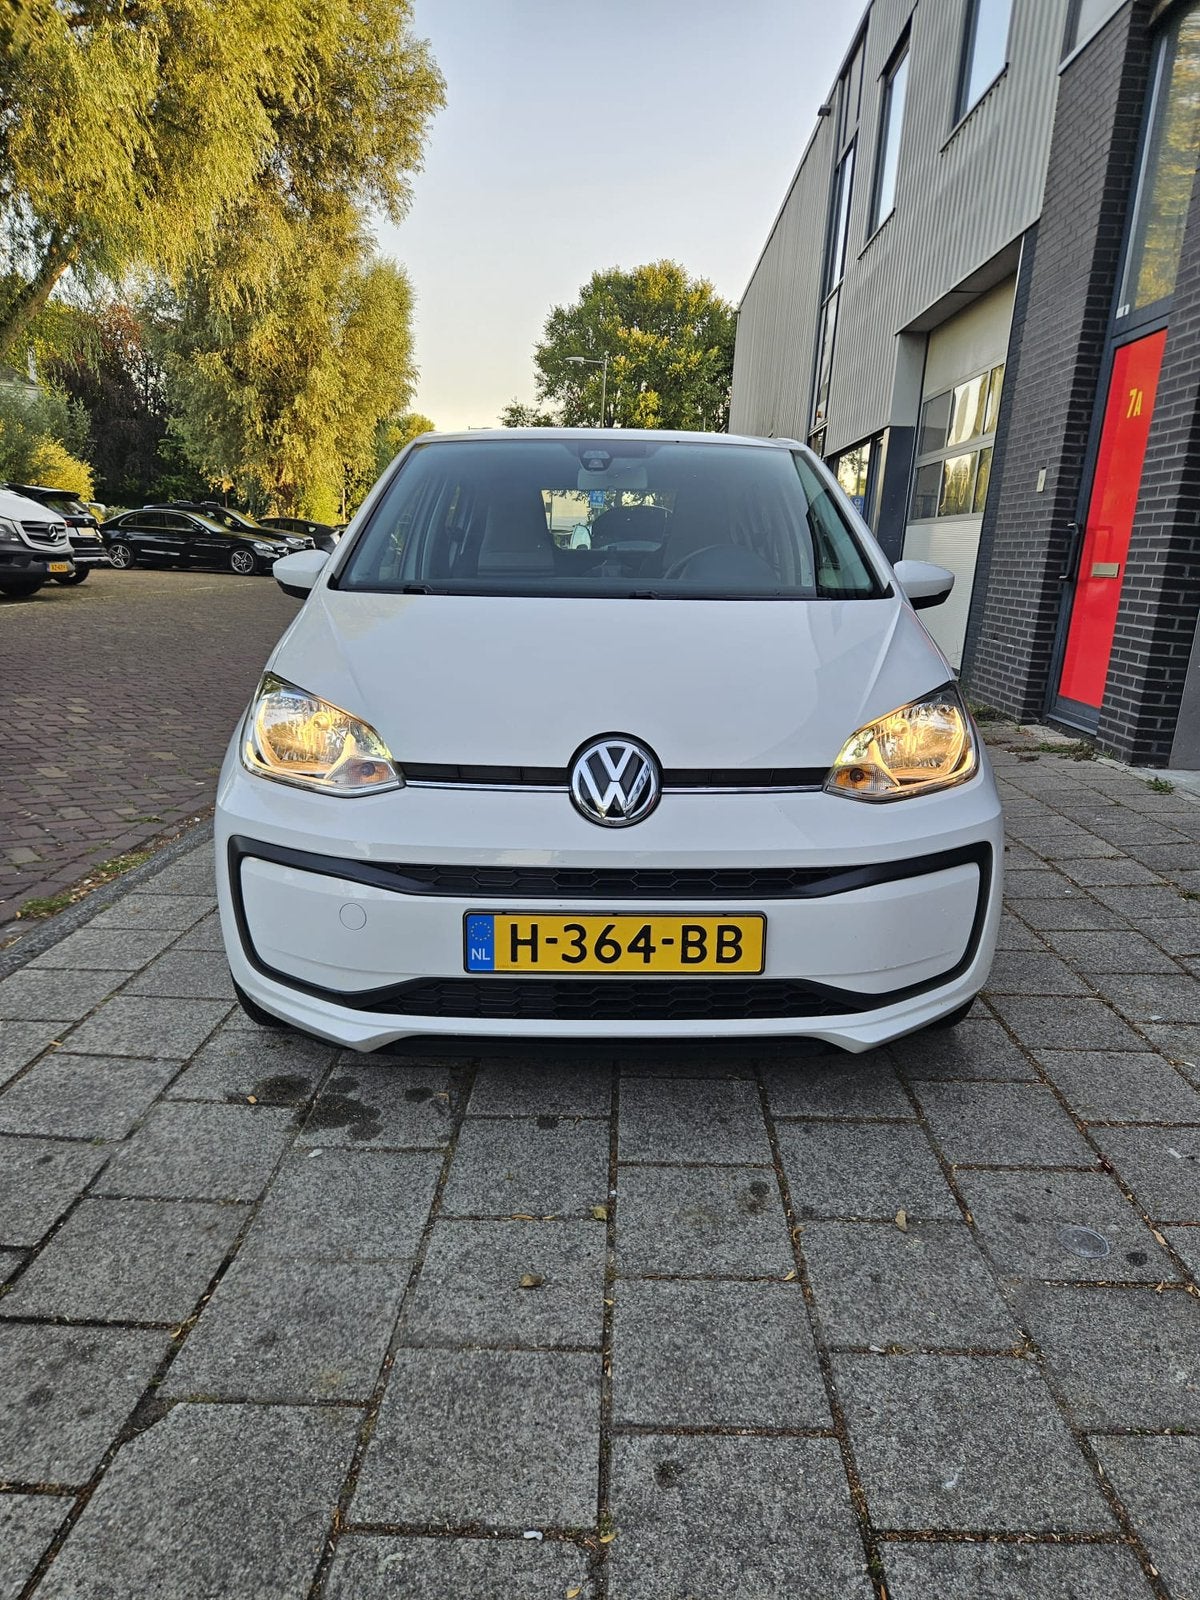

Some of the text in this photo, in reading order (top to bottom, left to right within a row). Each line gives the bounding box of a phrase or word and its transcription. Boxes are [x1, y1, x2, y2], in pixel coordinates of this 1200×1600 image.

[1126, 388, 1143, 419] 7A
[471, 948, 491, 961] NL
[509, 923, 743, 964] H-364-BB
